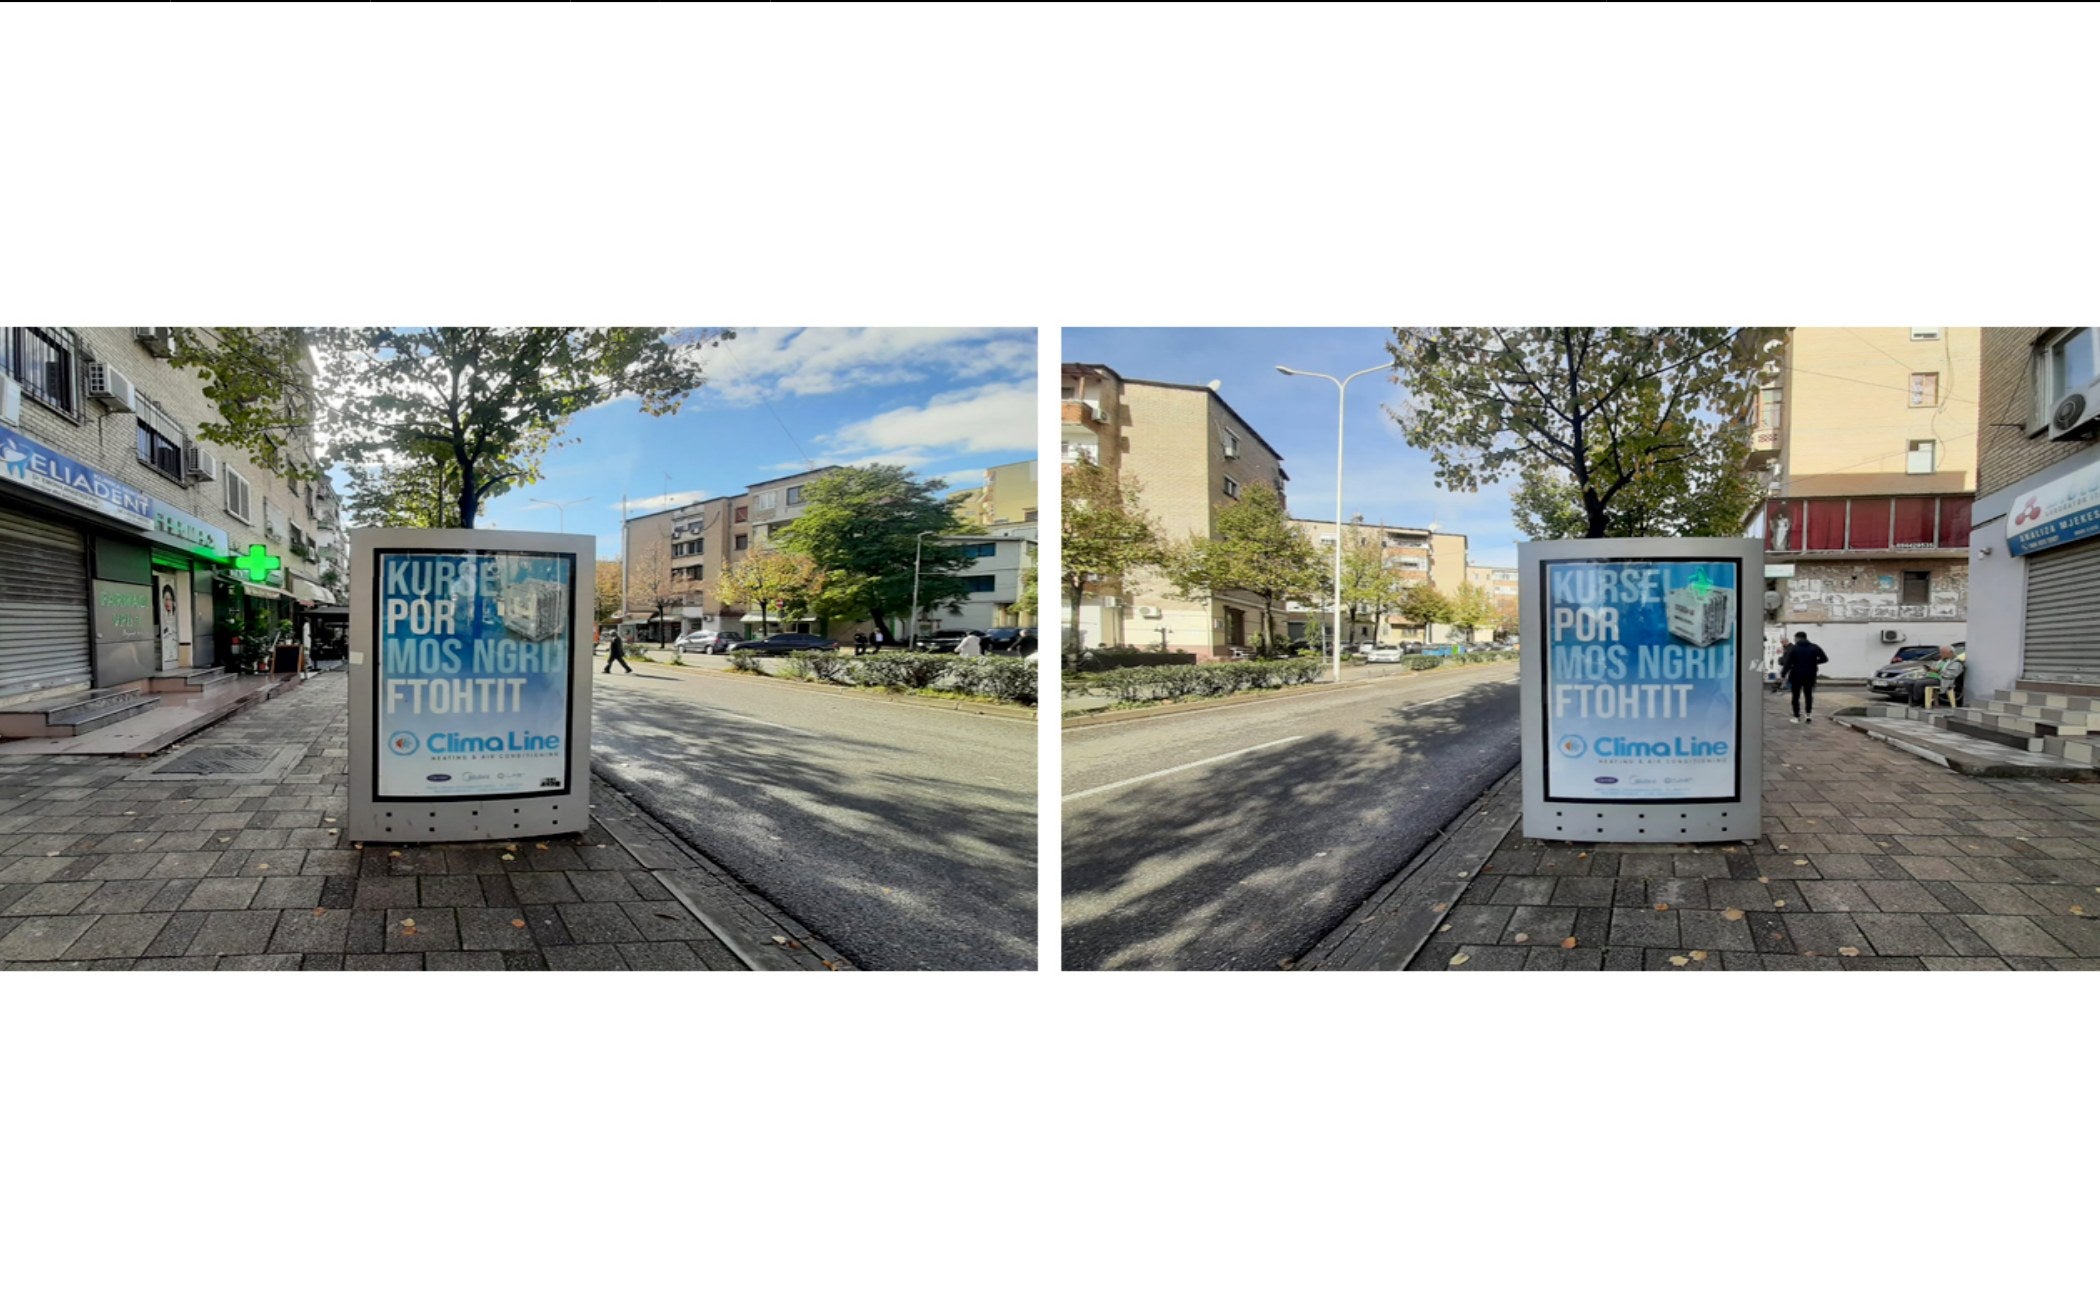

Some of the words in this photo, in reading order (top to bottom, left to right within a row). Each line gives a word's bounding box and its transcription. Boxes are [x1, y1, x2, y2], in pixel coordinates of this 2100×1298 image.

[31, 453, 149, 515] ELIADENT
[387, 599, 455, 635] POR
[1554, 607, 1619, 642] POR
[387, 638, 462, 674] MOS
[1553, 645, 1628, 680] MOS
[1638, 644, 1730, 680] NGRIJ
[387, 678, 527, 715] FTOHTIT
[1555, 684, 1694, 719] FTOHTIT
[427, 732, 504, 753] Clima
[508, 731, 560, 751] Line
[1594, 736, 1671, 757] Clima
[1675, 736, 1728, 756] Line
